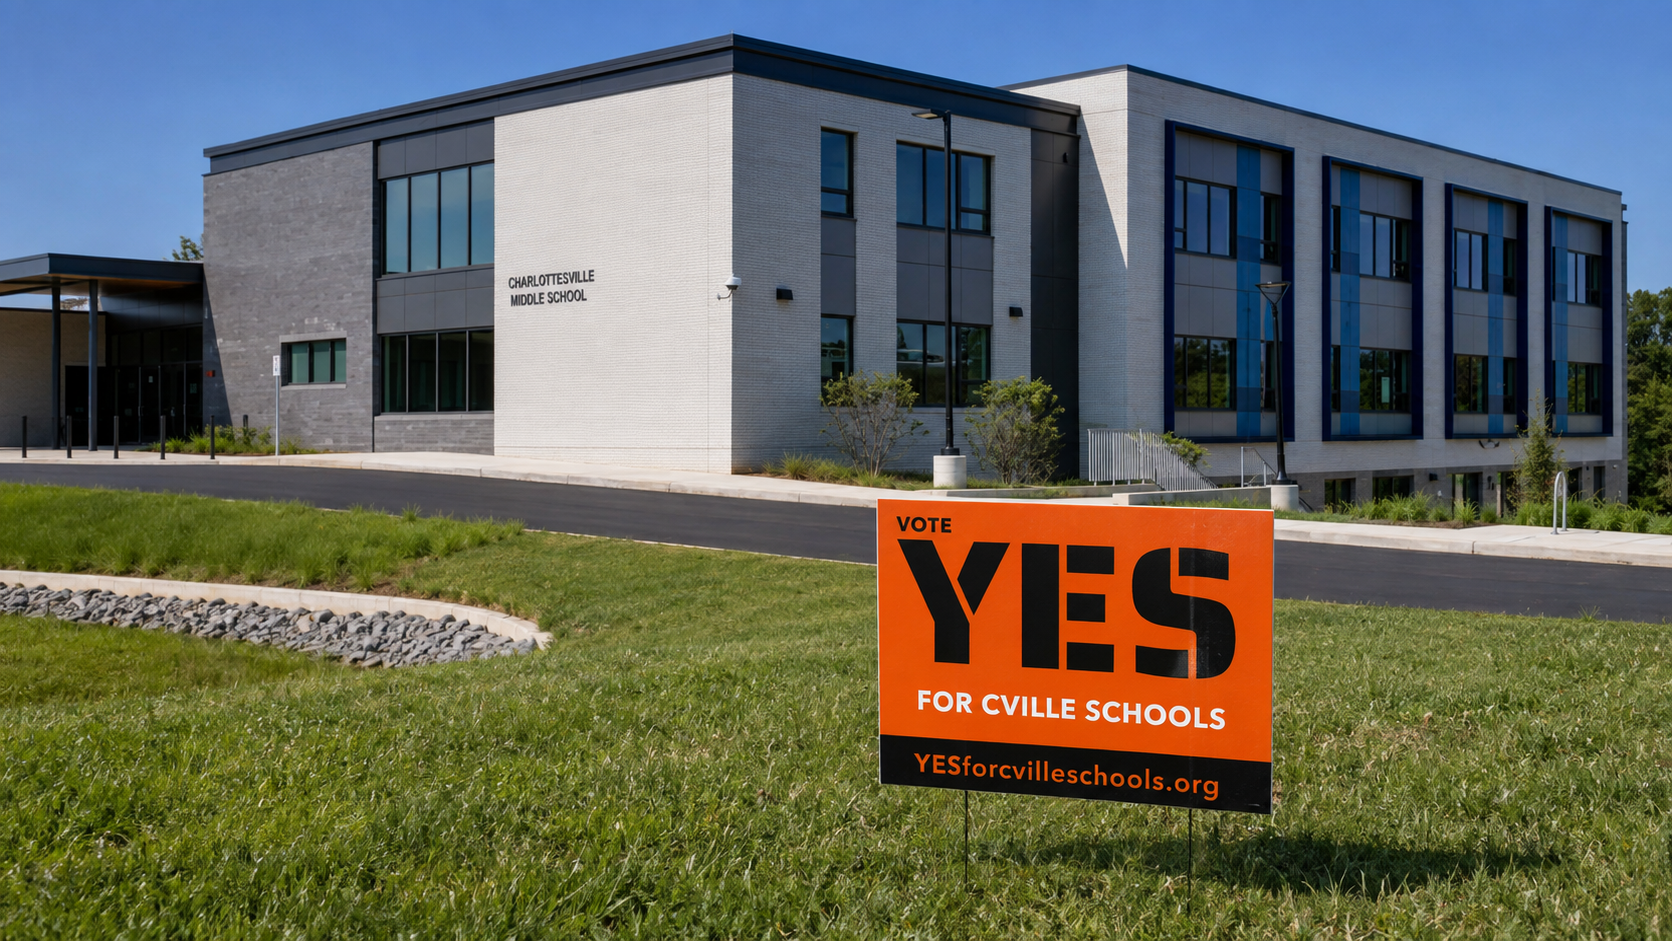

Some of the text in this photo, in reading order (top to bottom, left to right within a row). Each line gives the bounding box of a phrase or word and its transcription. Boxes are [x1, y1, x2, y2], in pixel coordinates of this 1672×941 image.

[508, 269, 595, 289] CHARLOTTESVILLE
[510, 289, 588, 307] MIDDLE SCHOOL
[896, 516, 952, 534] VOTE
[897, 538, 1236, 680] YES
[917, 689, 1226, 730] FOR CVILLE SCHOOLS
[914, 752, 1220, 801] YESforcvilleschools.org
